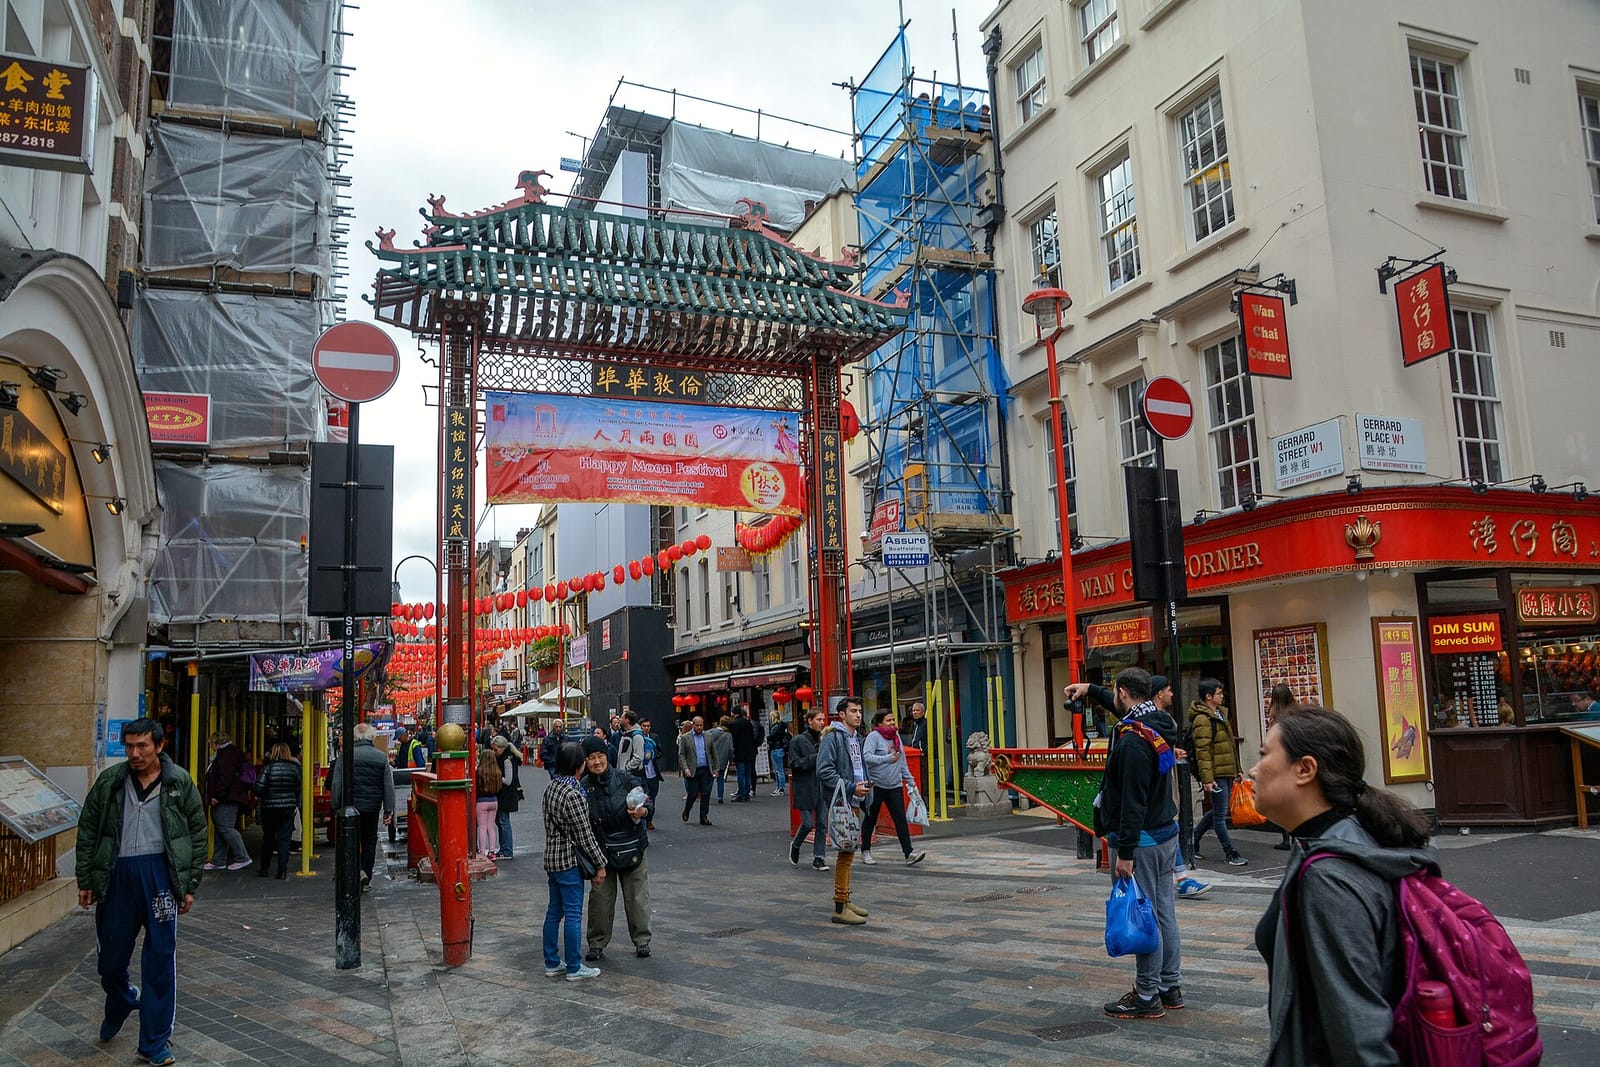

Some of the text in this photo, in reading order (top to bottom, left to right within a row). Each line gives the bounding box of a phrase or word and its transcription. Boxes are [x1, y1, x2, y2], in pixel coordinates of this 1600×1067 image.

[22, 135, 55, 149] 2818
[1251, 303, 1275, 318] Wan
[1253, 325, 1279, 340] Chai
[1249, 347, 1287, 363] Corner
[1364, 418, 1402, 433] GERRARD
[1277, 430, 1315, 451] GERRARD
[1365, 431, 1405, 445] PLACE W1
[1278, 441, 1323, 463] STREET W1
[580, 456, 728, 478] Happy Moon Festival
[1281, 479, 1289, 487] CITY
[1295, 471, 1322, 482] WESTMINSTER
[885, 536, 926, 545] Assure
[1183, 542, 1263, 578] ORNER
[1081, 572, 1116, 598] WAN
[1097, 621, 1140, 634] DIM SUM DAILY
[1433, 621, 1495, 635] DIM SUM
[1434, 634, 1496, 646] served daily
